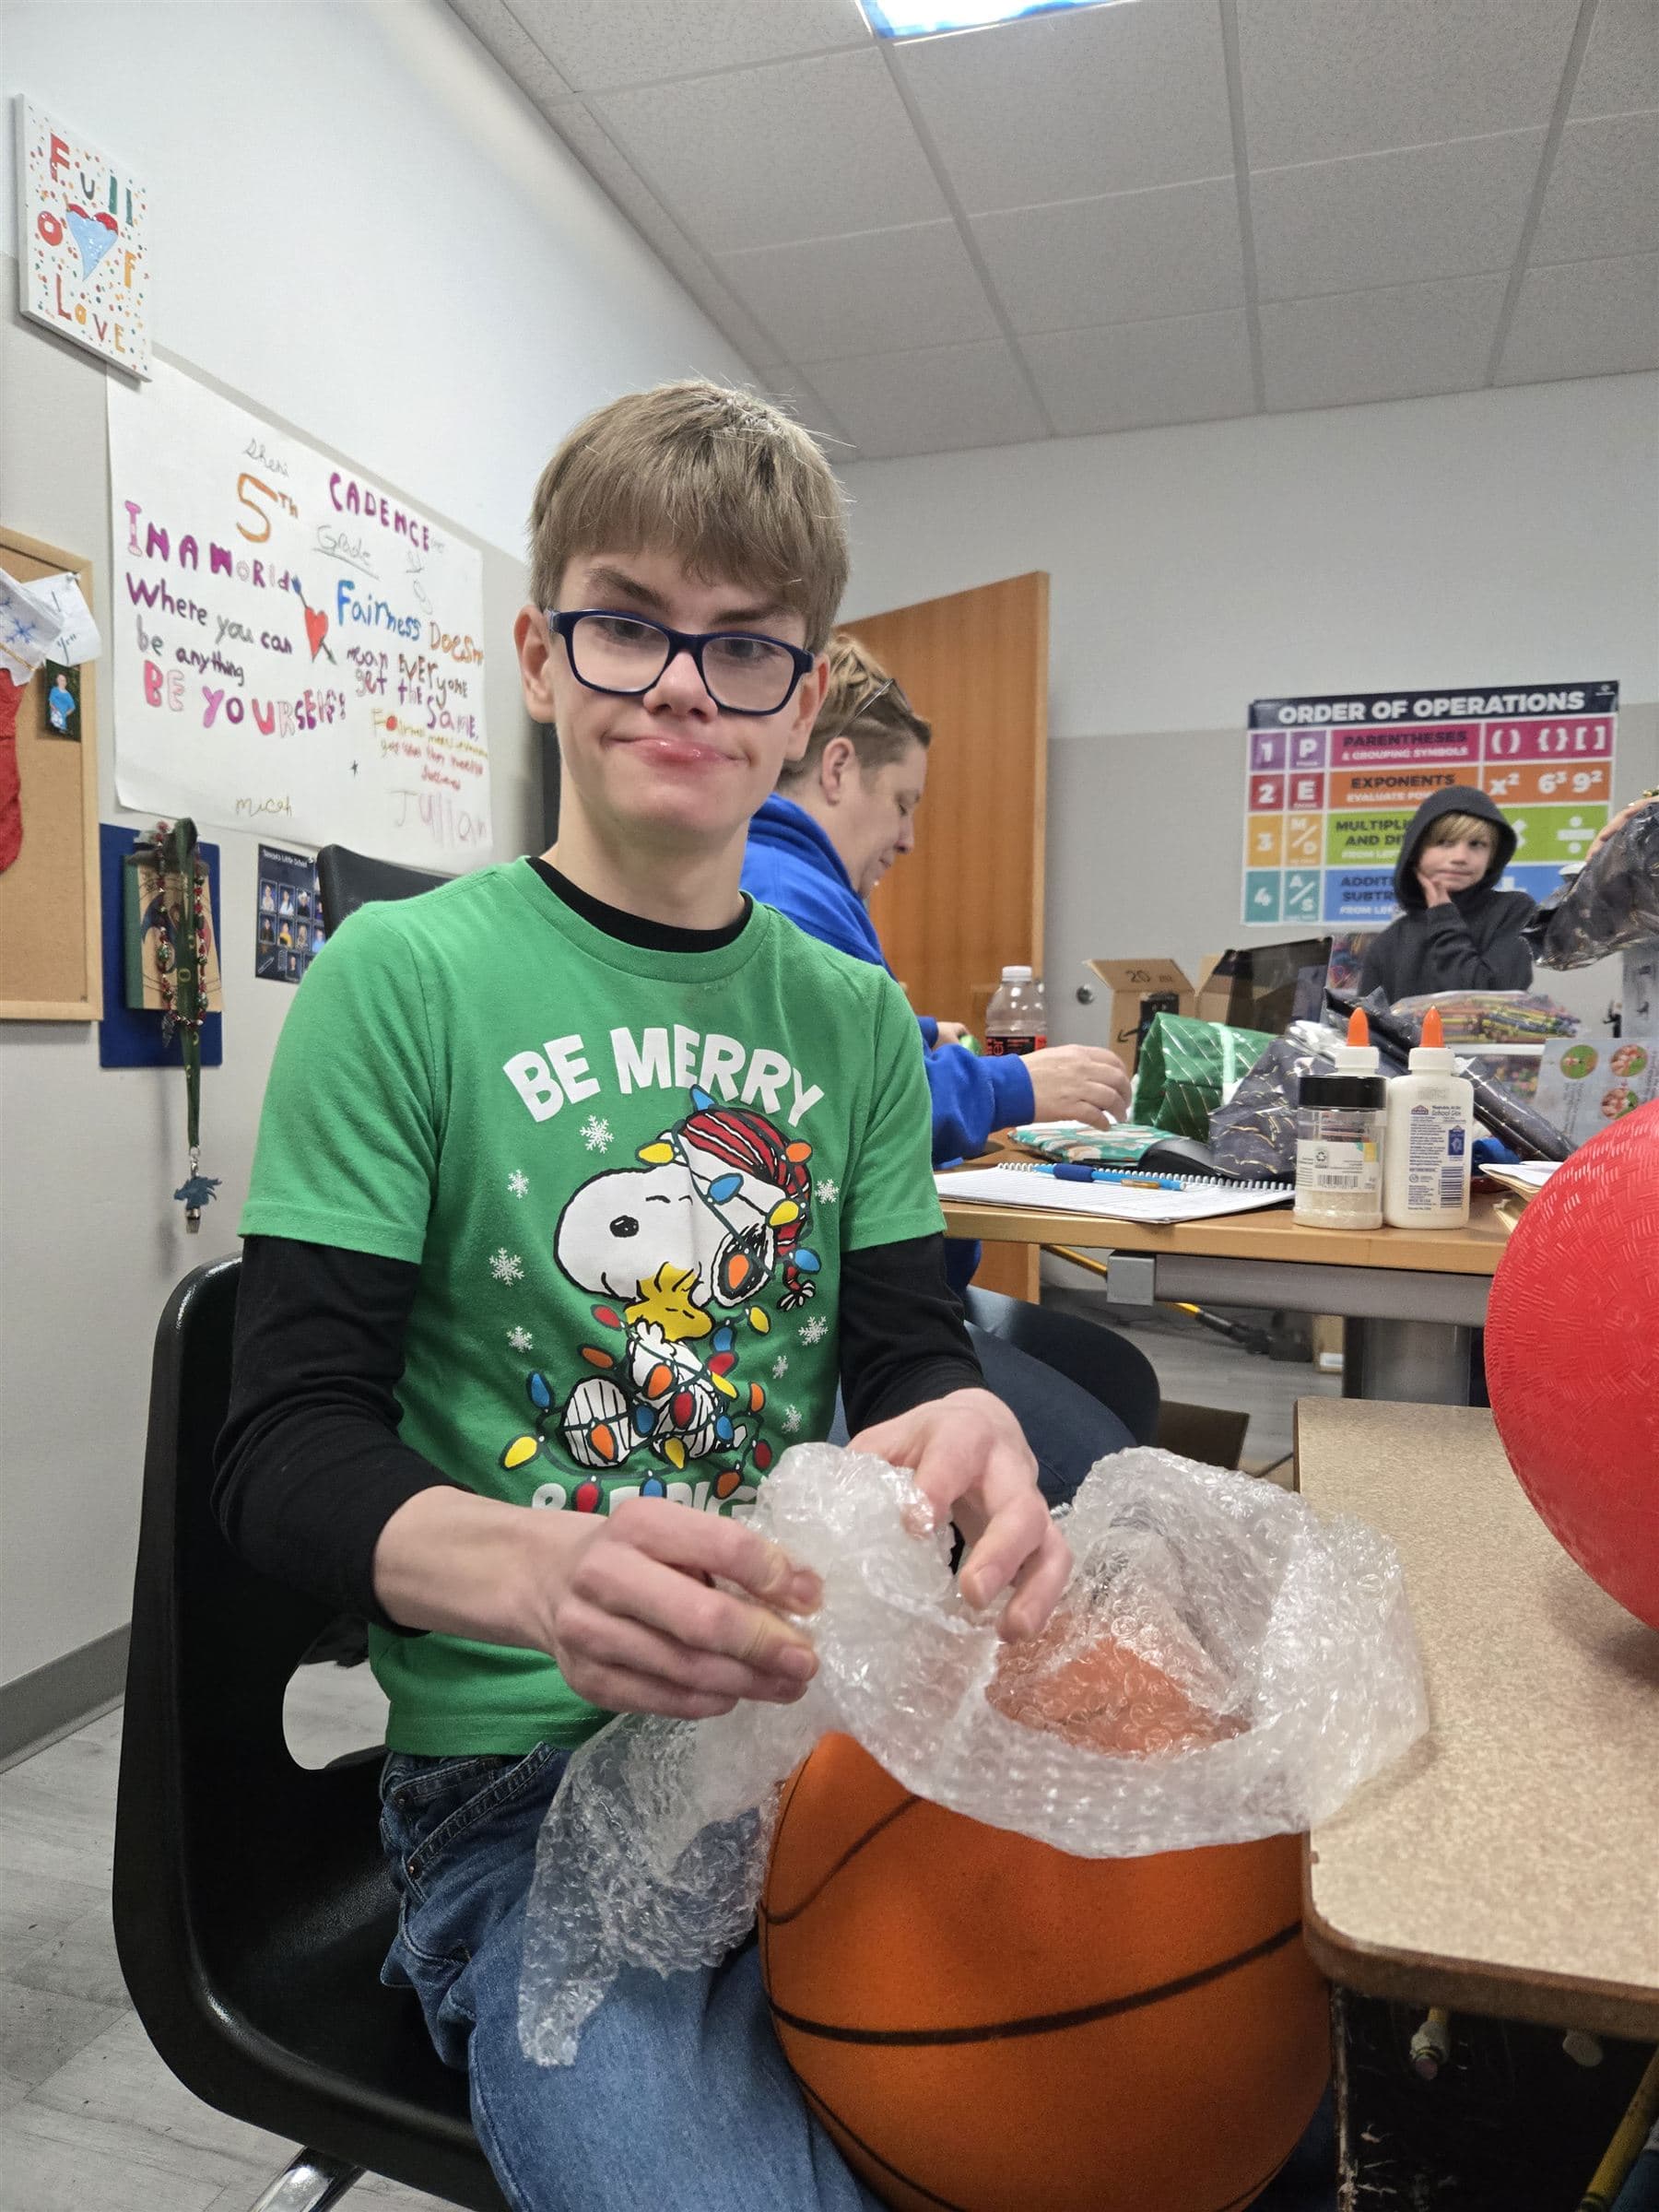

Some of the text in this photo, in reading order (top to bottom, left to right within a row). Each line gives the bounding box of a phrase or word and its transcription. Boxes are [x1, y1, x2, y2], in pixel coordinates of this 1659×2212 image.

[330, 472, 429, 552] CADENCE
[126, 571, 292, 654] Where you can
[337, 580, 421, 641] Fairness
[136, 614, 244, 687] be anything
[144, 659, 184, 712] BE
[1278, 691, 1585, 724] ORDER OF OPERATIONS
[1299, 738, 1317, 759] P
[1343, 731, 1467, 747] PARENTHESES
[1261, 741, 1273, 762] 1
[1413, 746, 1468, 758] SYMBOLS
[1297, 781, 1315, 800] E
[1351, 774, 1455, 789] EXPONENTS
[1258, 784, 1275, 805] 2
[1257, 832, 1273, 851] 3
[1346, 835, 1380, 846] AND
[1253, 888, 1272, 907] 4
[502, 1024, 825, 1127] BE MERRY
